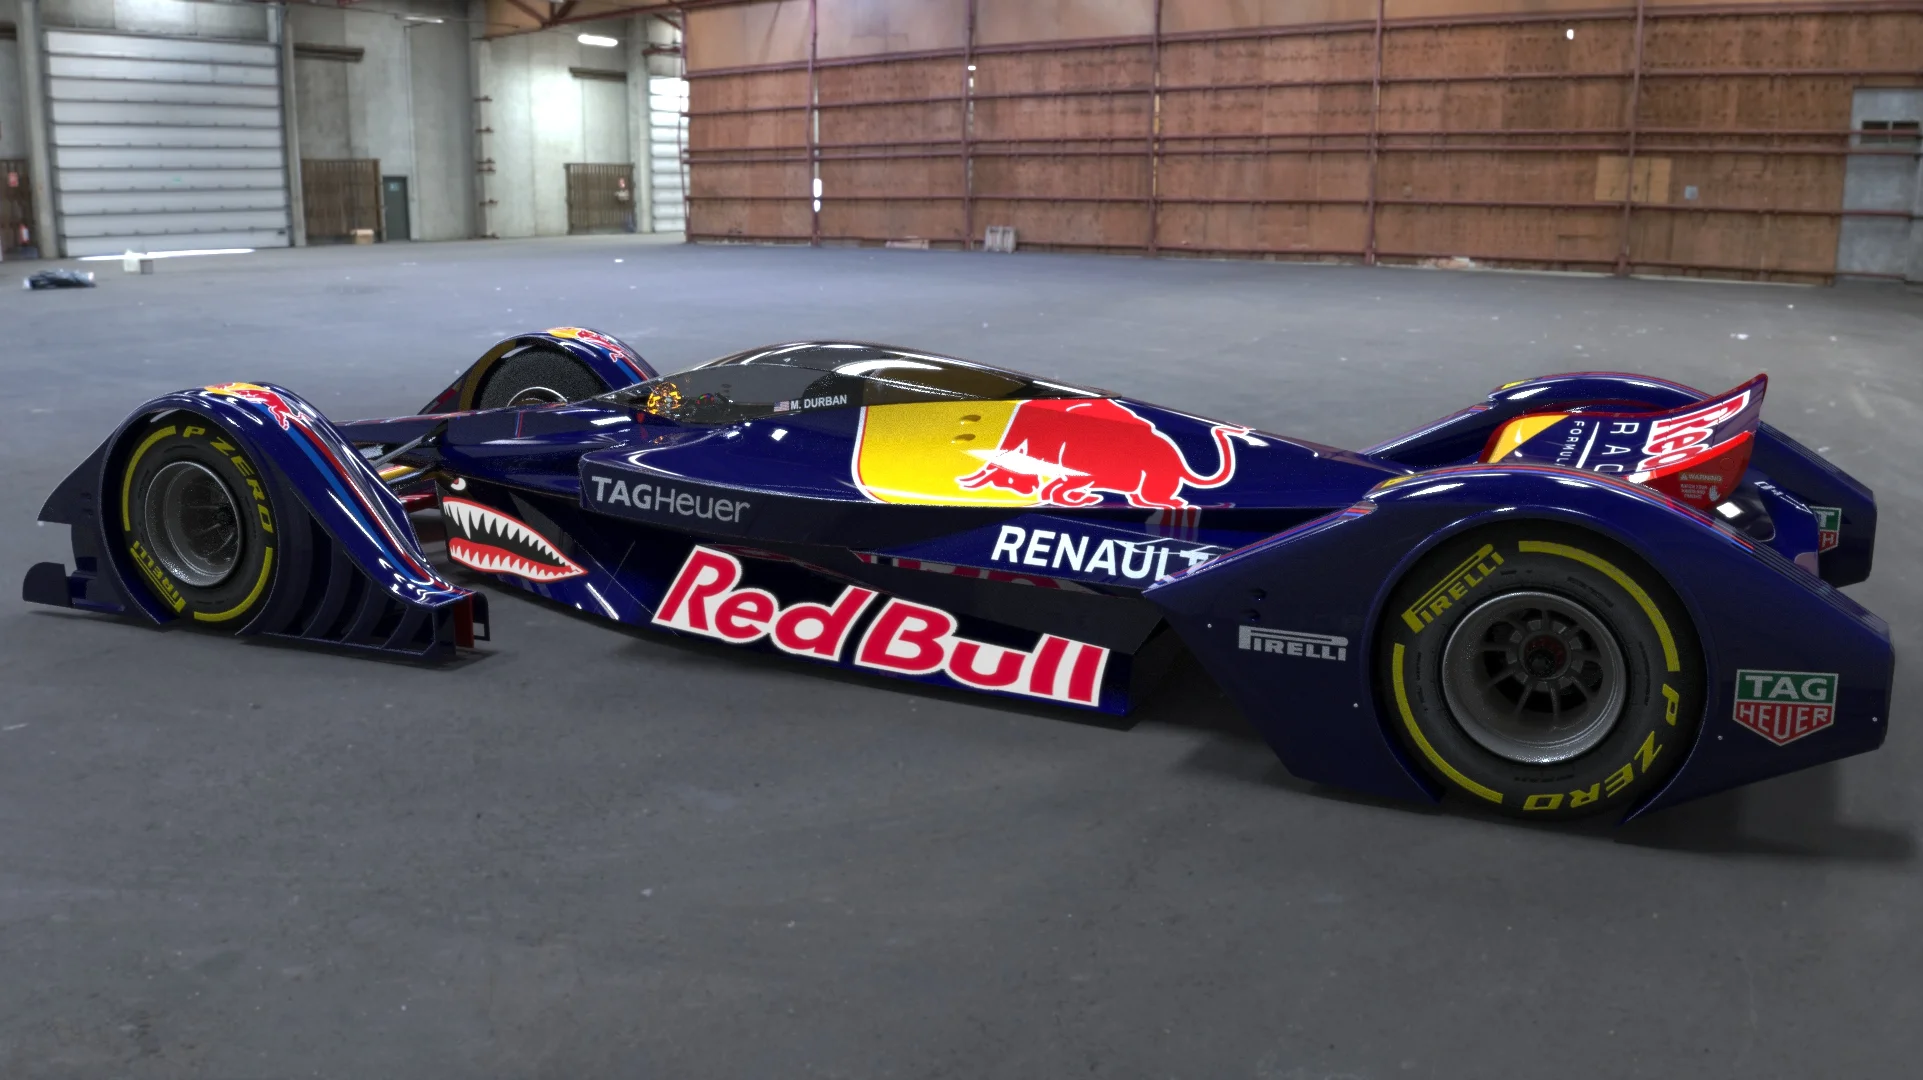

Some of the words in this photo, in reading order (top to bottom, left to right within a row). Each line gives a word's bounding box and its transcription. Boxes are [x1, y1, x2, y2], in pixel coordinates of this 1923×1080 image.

[790, 400, 802, 411] M.
[803, 394, 848, 409] DURBAN
[1554, 420, 1586, 467] FORMUL
[182, 425, 206, 438] P
[209, 436, 274, 534] ZERO
[130, 540, 187, 613] PIRELLI
[991, 525, 1210, 582] RENAULT
[1401, 543, 1505, 634] PIRELLI
[652, 545, 879, 662] Red
[855, 597, 1110, 707] Bull
[1238, 625, 1349, 662] PIRELLI
[1662, 683, 1680, 727] P
[1745, 674, 1828, 701] TAG
[1739, 704, 1829, 740] HEUER
[1522, 730, 1663, 812] ZERO
